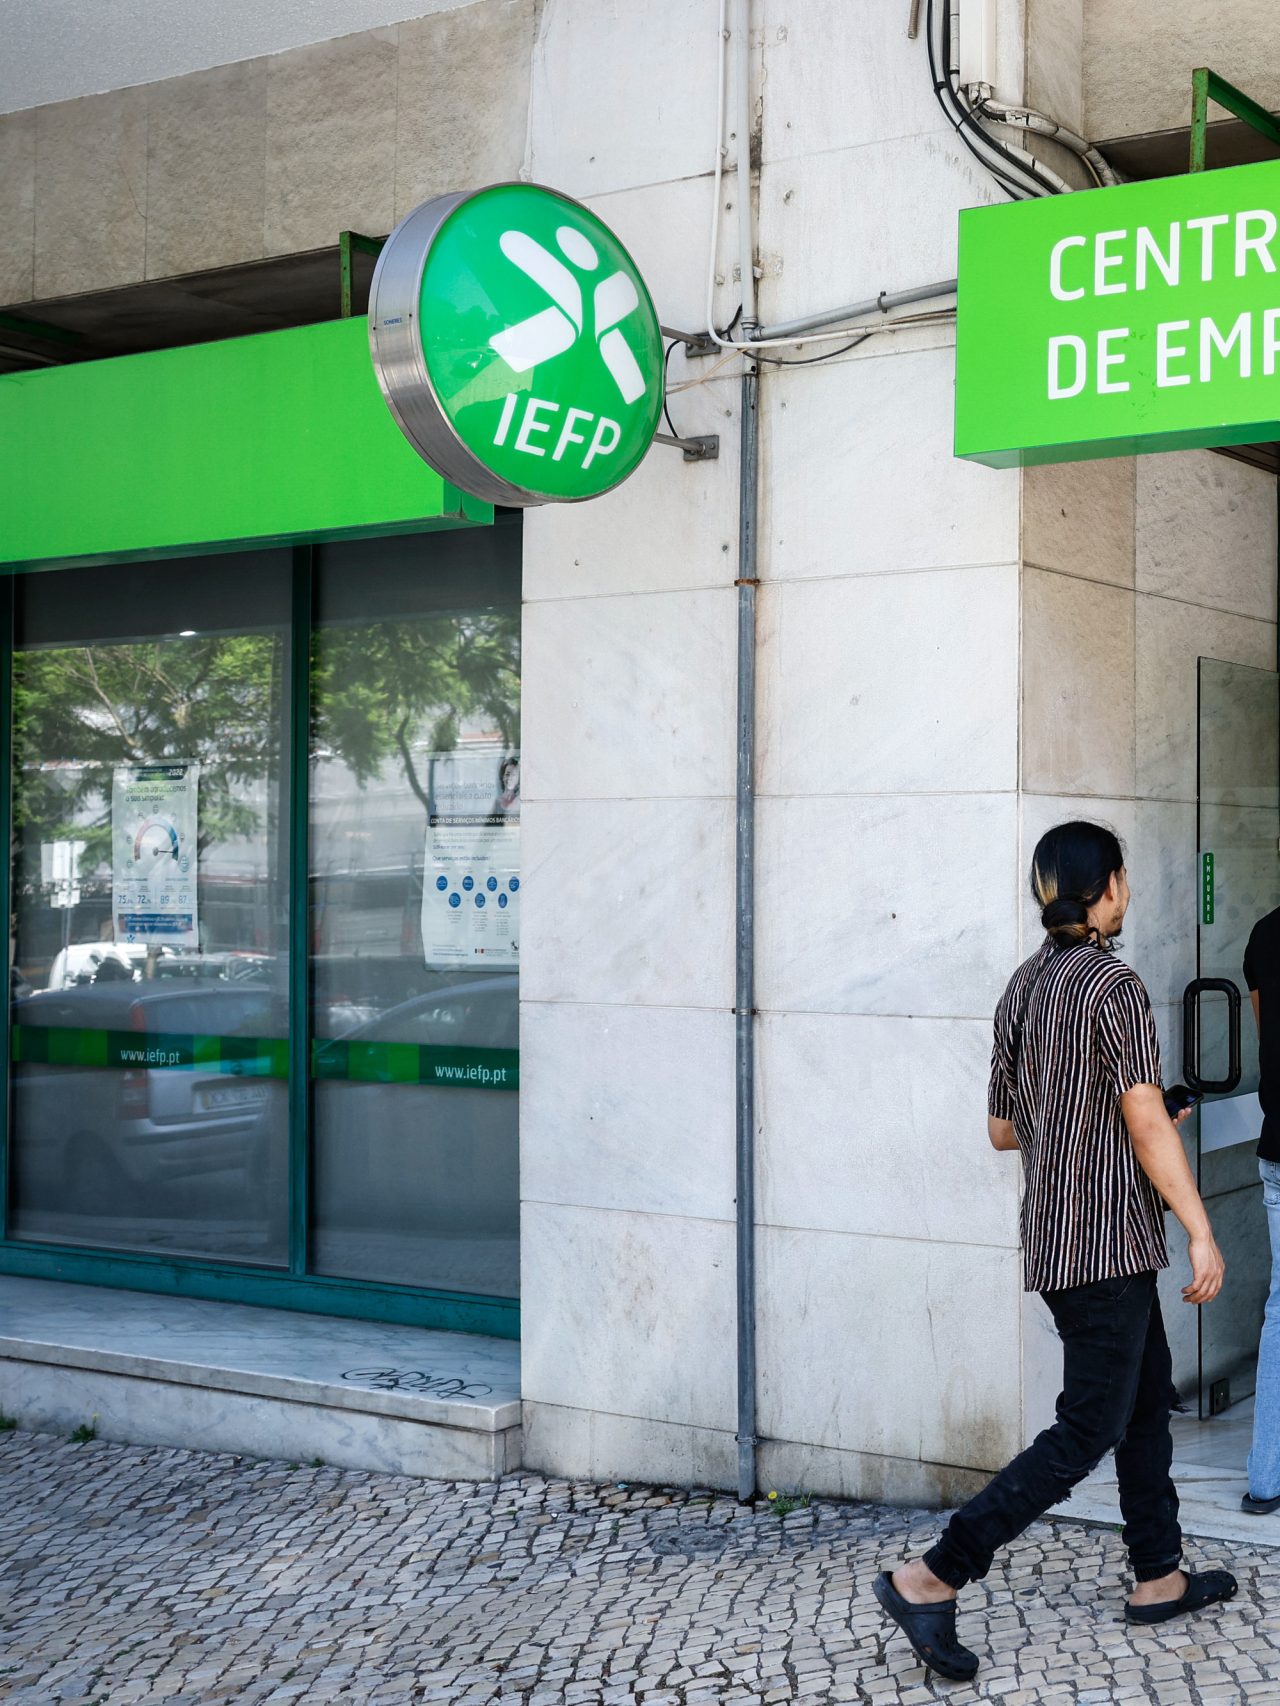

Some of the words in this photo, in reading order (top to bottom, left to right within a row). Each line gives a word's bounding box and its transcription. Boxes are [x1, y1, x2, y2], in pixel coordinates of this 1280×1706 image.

[1047, 327, 1130, 400] DE
[493, 393, 622, 470] IEFP
[167, 768, 184, 776] 2022
[120, 1048, 180, 1066] www.iefp.pt
[435, 1064, 507, 1084] www.iefp.pt
